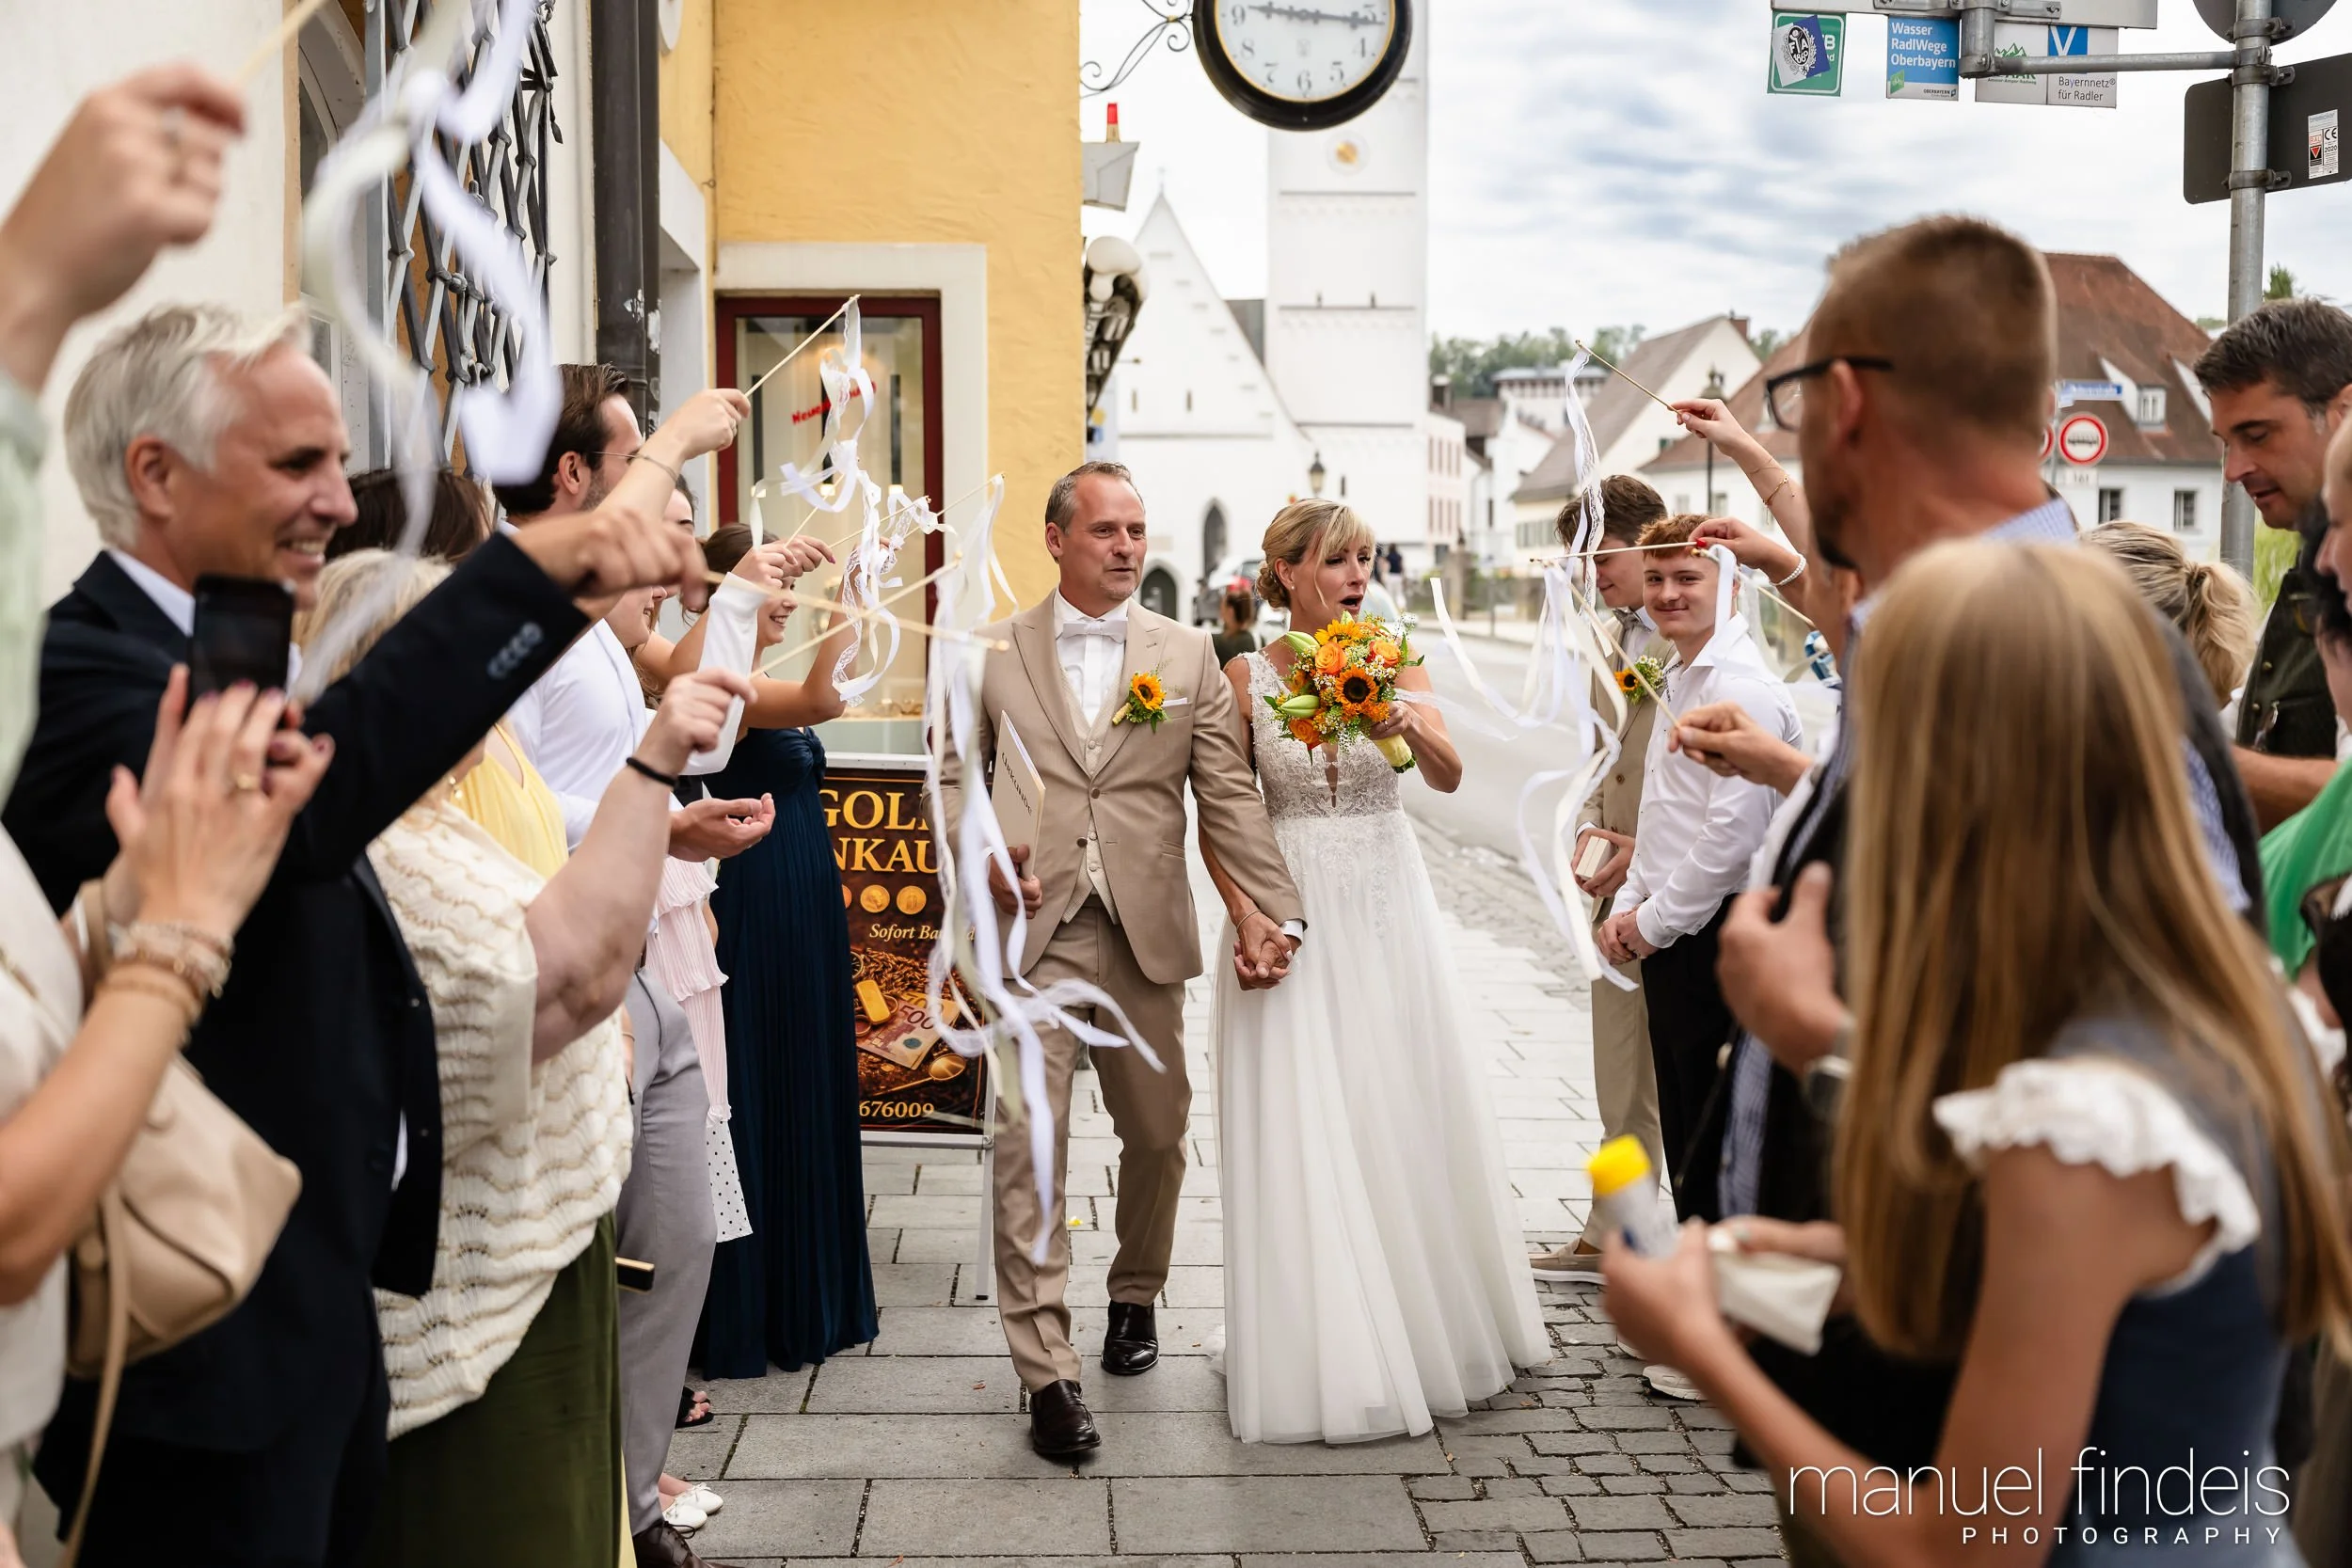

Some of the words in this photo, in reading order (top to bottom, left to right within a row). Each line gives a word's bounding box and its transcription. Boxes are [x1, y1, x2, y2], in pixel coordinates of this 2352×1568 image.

[1232, 5, 1246, 25] 9
[1891, 22, 1932, 36] Wasser
[1891, 38, 1947, 55] RadlWege
[1330, 61, 1344, 83] 5
[1890, 54, 1956, 71] Oberbayern
[1297, 71, 1311, 91] 6
[2058, 90, 2072, 100] für
[2074, 90, 2104, 102] Radler
[1001, 752, 1033, 816] URKUNDE
[818, 789, 930, 831] GOL
[869, 923, 916, 942] Sofort
